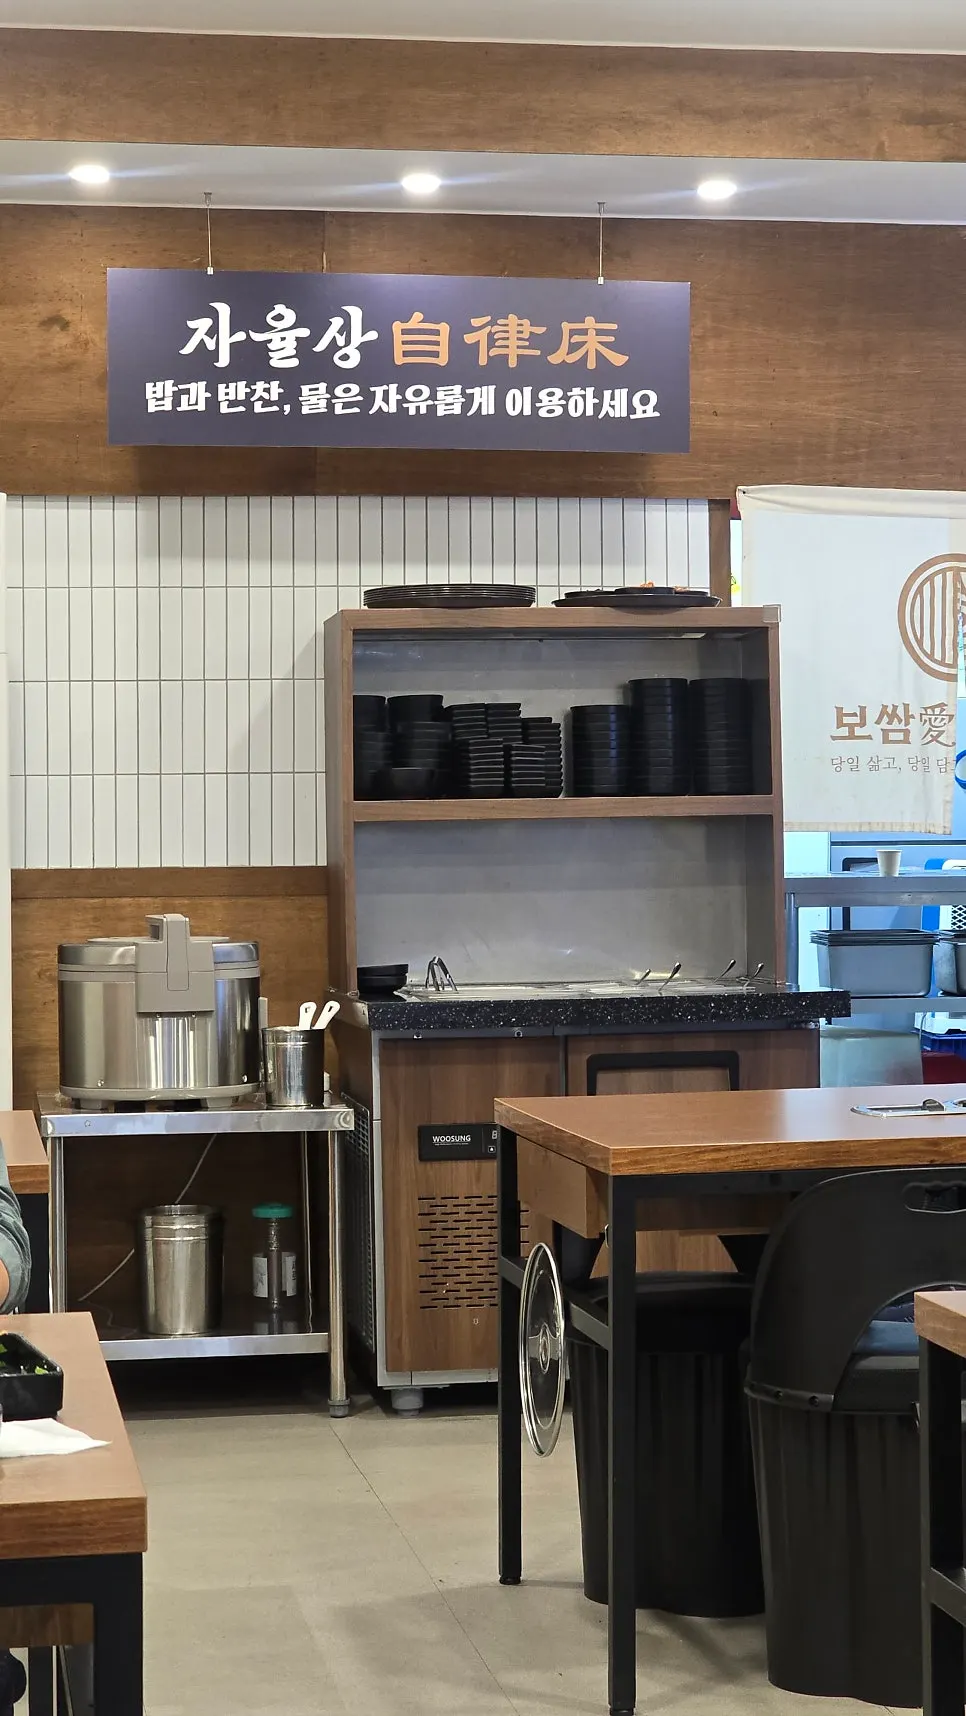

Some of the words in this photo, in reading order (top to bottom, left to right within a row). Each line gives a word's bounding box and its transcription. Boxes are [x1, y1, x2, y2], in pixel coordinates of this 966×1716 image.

[179, 302, 378, 368] 자율상
[392, 312, 629, 370] 自律床
[145, 380, 211, 413] 밥과
[217, 381, 291, 415] 반찬,
[299, 382, 363, 414] 물은
[368, 384, 497, 416] 자유롭게
[505, 386, 661, 420] 이용하세요
[830, 702, 956, 748] 보쌈愛
[831, 755, 861, 773] 당일
[908, 756, 931, 773] 당일
[432, 1135, 471, 1143] WOOSUNG
